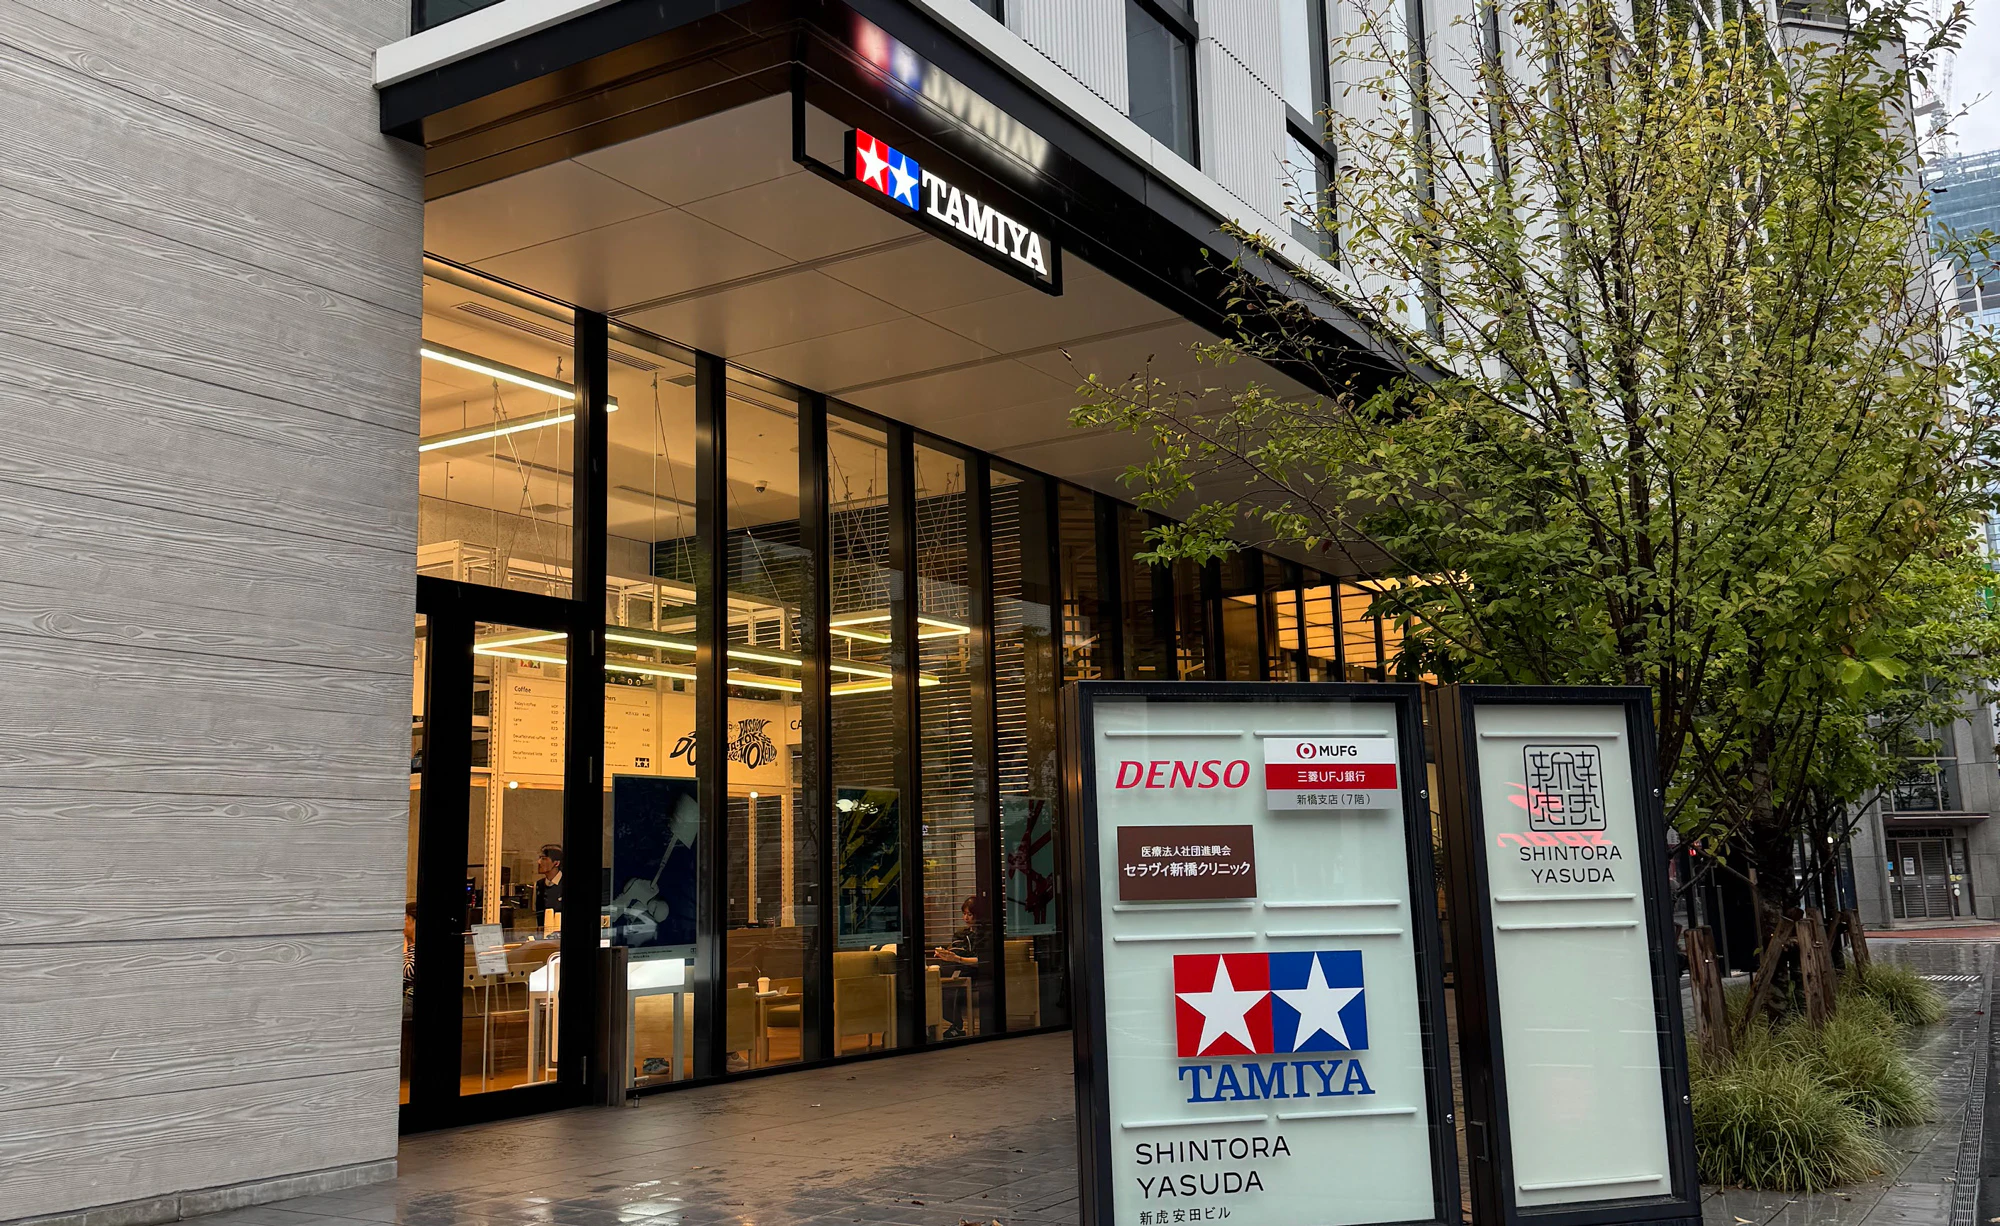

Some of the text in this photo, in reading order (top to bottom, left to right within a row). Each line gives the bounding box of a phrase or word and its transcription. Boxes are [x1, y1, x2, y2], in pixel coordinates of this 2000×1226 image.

[922, 168, 1048, 276] TAMIYA
[514, 685, 531, 693] Coffee
[1319, 745, 1358, 757] MUFG
[1115, 759, 1250, 789] DENSO
[1297, 770, 1366, 783] 三菱UFJ銀行
[1141, 845, 1232, 858] 医療法人社団進興会
[1519, 845, 1623, 862] SHINTORA
[1123, 861, 1251, 877] セラヴィ新橋クリニック
[1530, 867, 1615, 884] YASUDA
[1178, 1058, 1376, 1104] TAMIYA
[1135, 1135, 1291, 1166] SHINTORA
[1136, 1170, 1265, 1200] YASUDA
[1139, 1206, 1231, 1226] 新虎安田ビル
